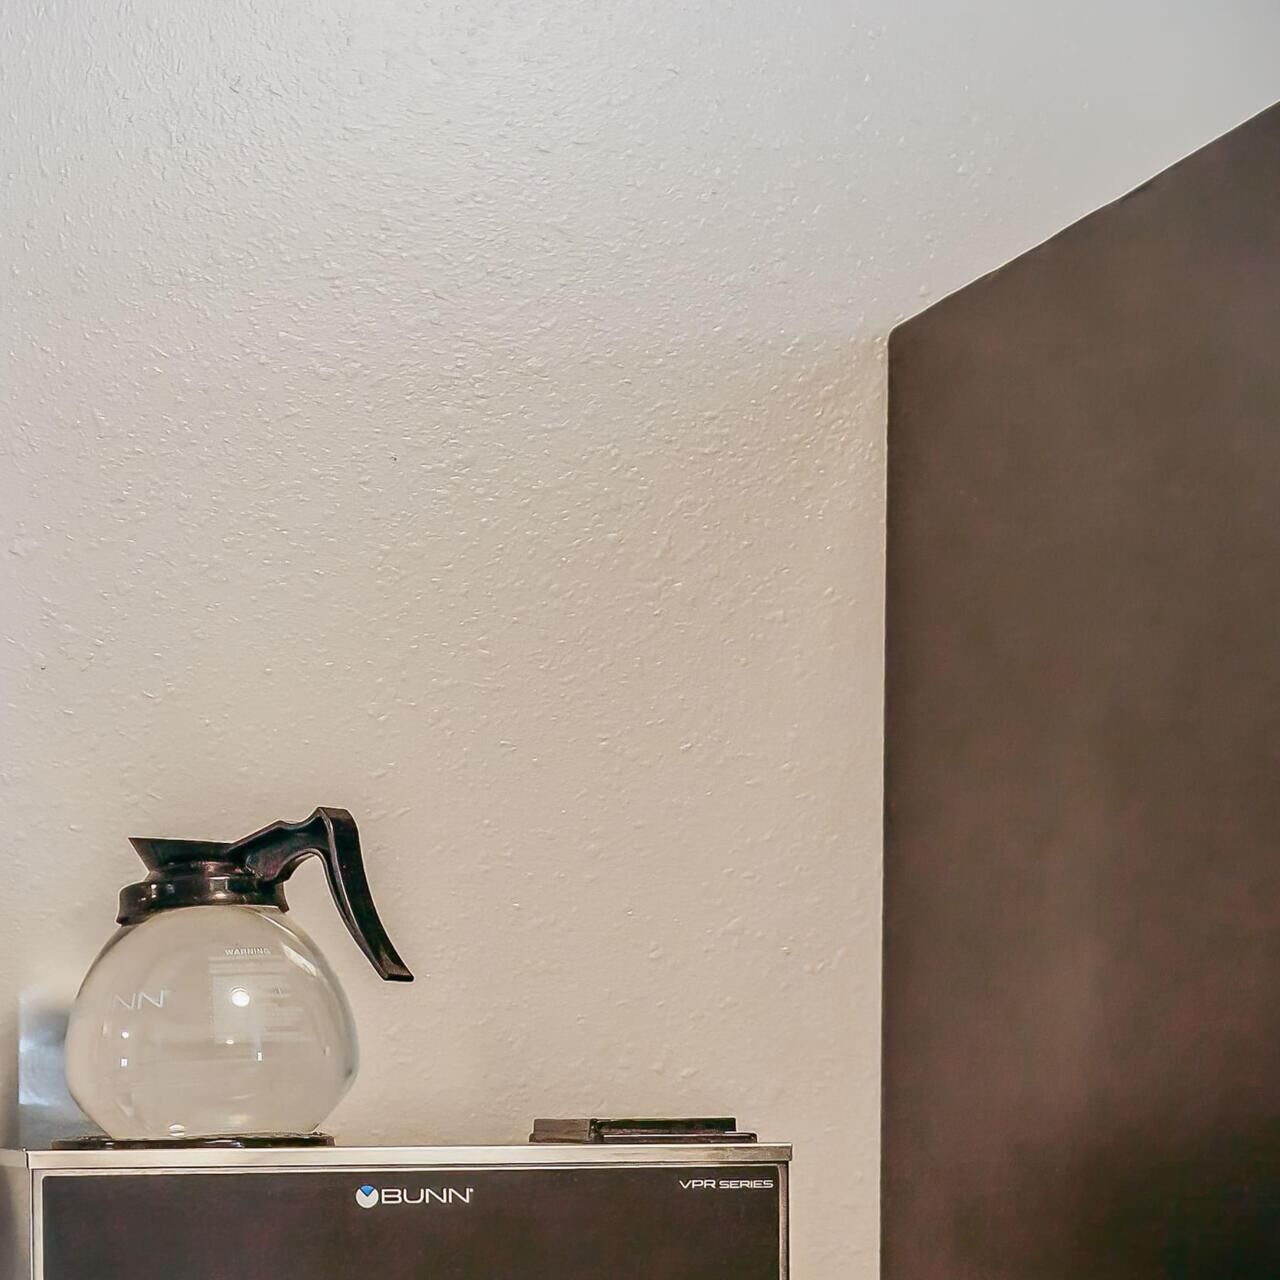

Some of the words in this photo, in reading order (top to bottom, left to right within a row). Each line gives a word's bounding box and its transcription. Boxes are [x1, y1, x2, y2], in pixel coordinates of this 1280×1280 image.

[679, 1179, 716, 1189] VPR
[719, 1179, 774, 1189] SERIES
[381, 1187, 470, 1204] BUNN
